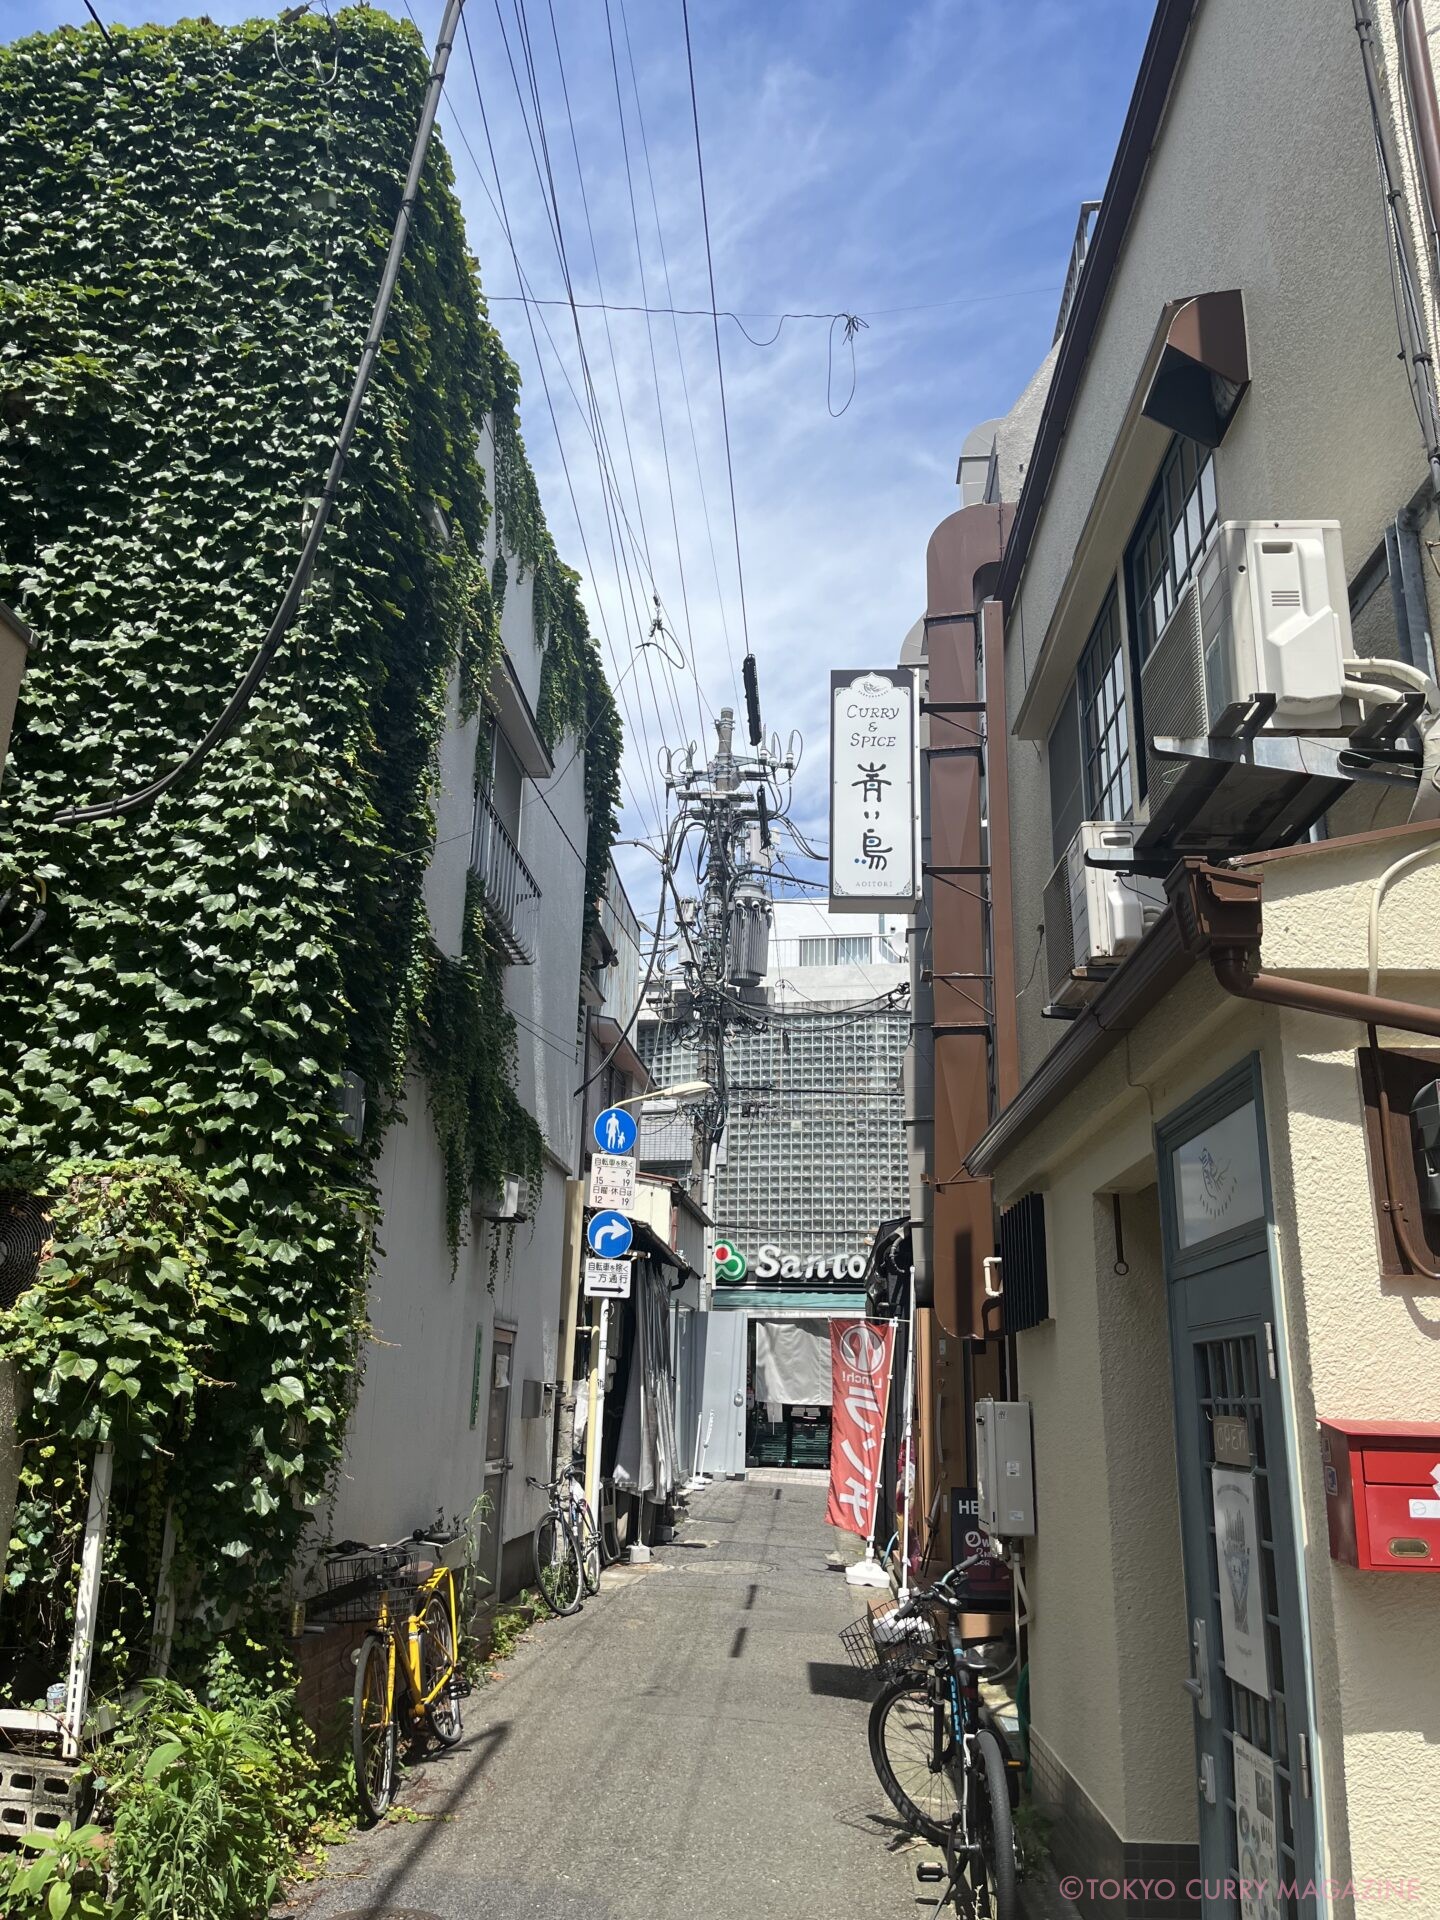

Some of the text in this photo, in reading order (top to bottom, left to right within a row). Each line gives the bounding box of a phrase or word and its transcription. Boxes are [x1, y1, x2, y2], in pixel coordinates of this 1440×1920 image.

[868, 721, 878, 732] &
[594, 1158, 633, 1168] 自転車を除く
[595, 1176, 604, 1185] 15
[623, 1178, 631, 1187] 19
[594, 1195, 603, 1204] 12
[621, 1197, 630, 1206] 19
[588, 1261, 629, 1273] 自転車を除く
[588, 1273, 628, 1284] 一方通行
[958, 1499, 979, 1515] HE
